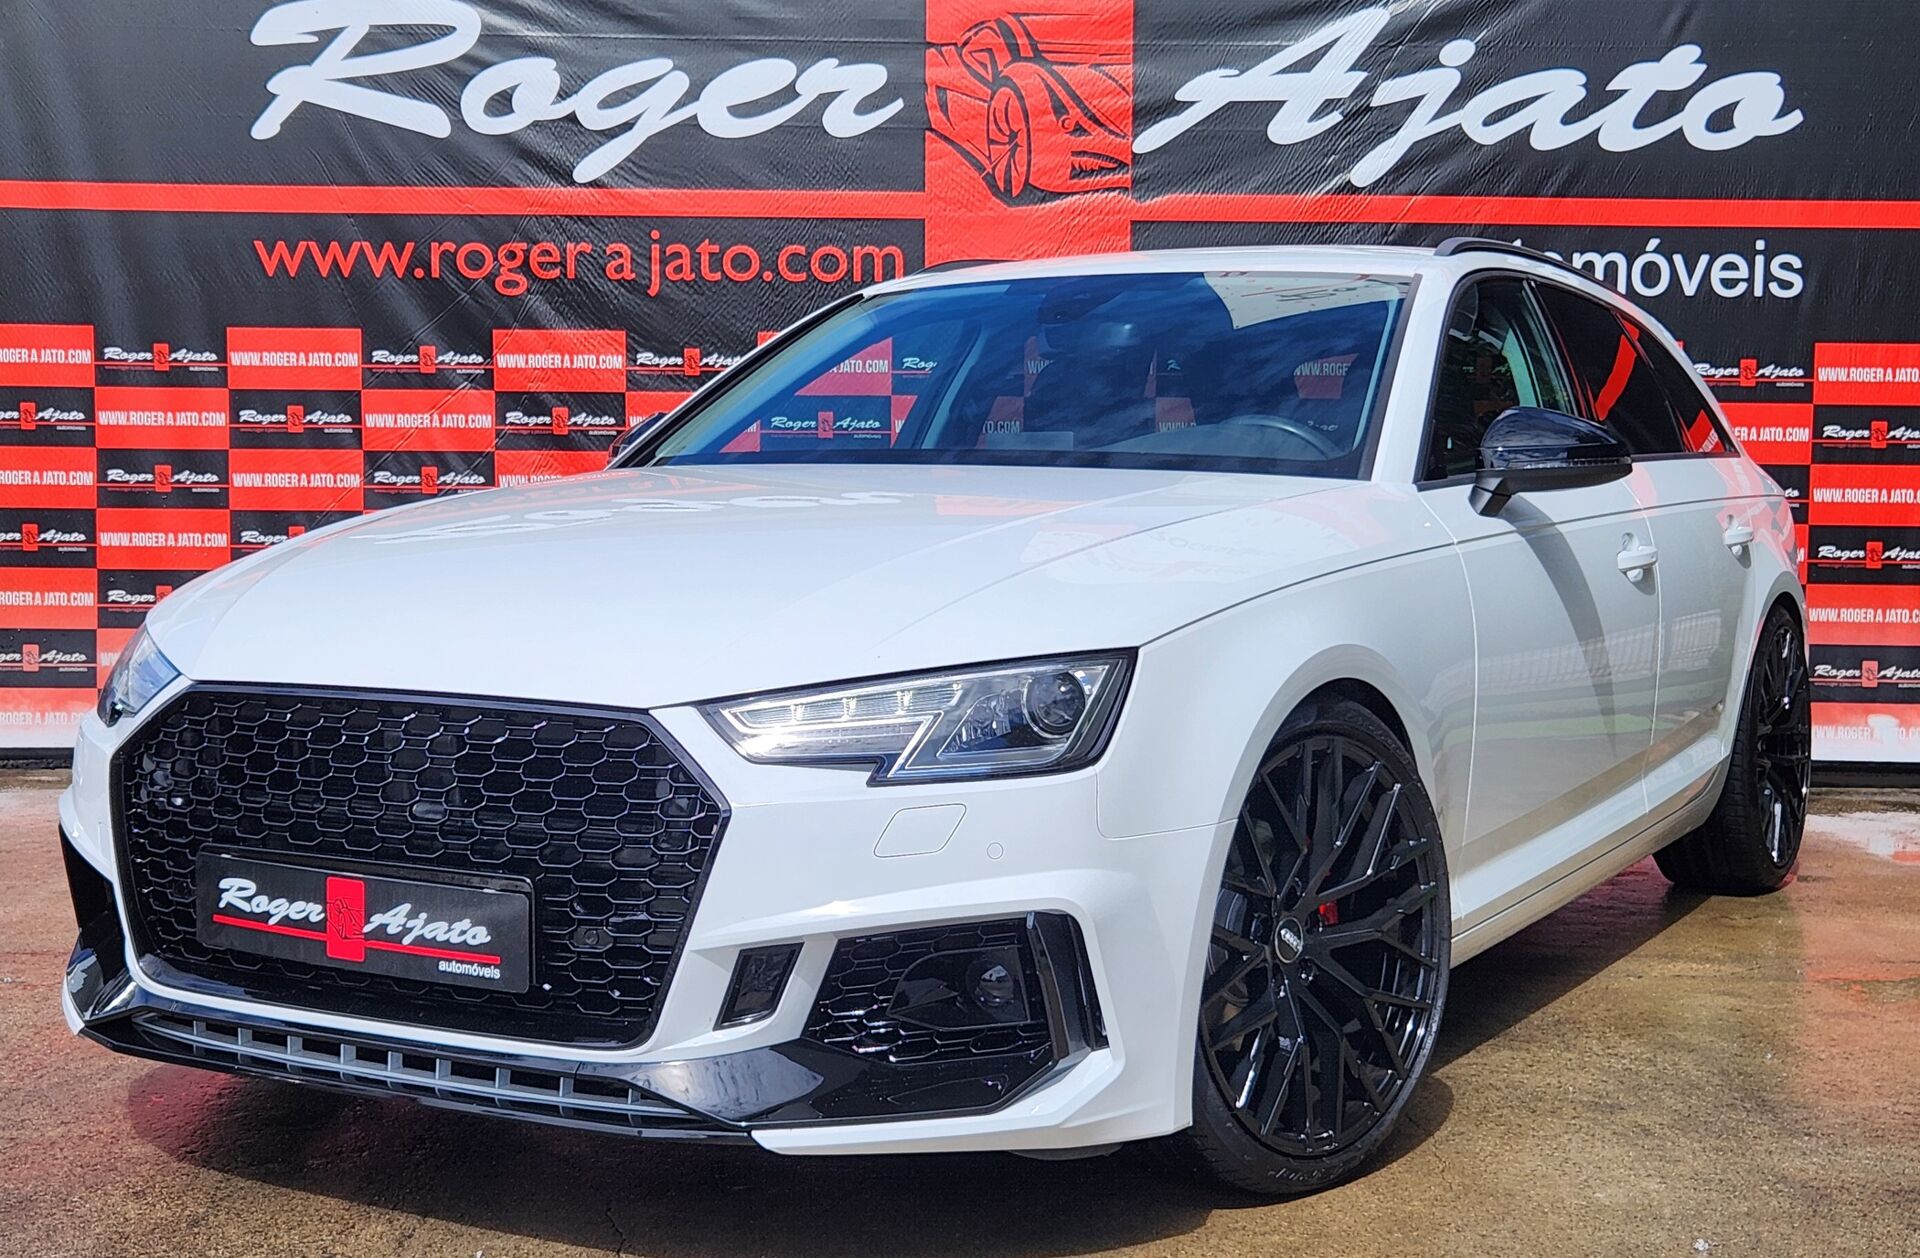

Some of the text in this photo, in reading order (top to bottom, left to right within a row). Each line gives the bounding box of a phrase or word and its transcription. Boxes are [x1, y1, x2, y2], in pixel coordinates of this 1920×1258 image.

[250, 0, 1804, 188] Roger Ajato
[103, 347, 218, 363] Roger Ajato
[371, 350, 485, 366] Roger Ajato
[636, 352, 683, 368] Roger
[1694, 363, 1804, 379] Roger Ajato
[35, 407, 86, 422] Ajato
[239, 410, 352, 425] Roger Ajato
[505, 411, 551, 427] Roger
[568, 411, 616, 427] Ajato
[770, 416, 817, 430] Roger
[833, 417, 880, 430] Ajato
[1822, 425, 1870, 440] Roger
[107, 469, 219, 484] Roger Ajato
[373, 471, 486, 486] Roger Ajato
[38, 529, 87, 543] Ajato
[241, 531, 289, 545] Roger
[1818, 545, 1865, 561] Roger
[107, 589, 155, 605] Roger
[38, 650, 87, 665] Ajato
[1814, 664, 1860, 679] Roger
[218, 877, 491, 945] Roger Ajato
[438, 959, 501, 980] automóveis
